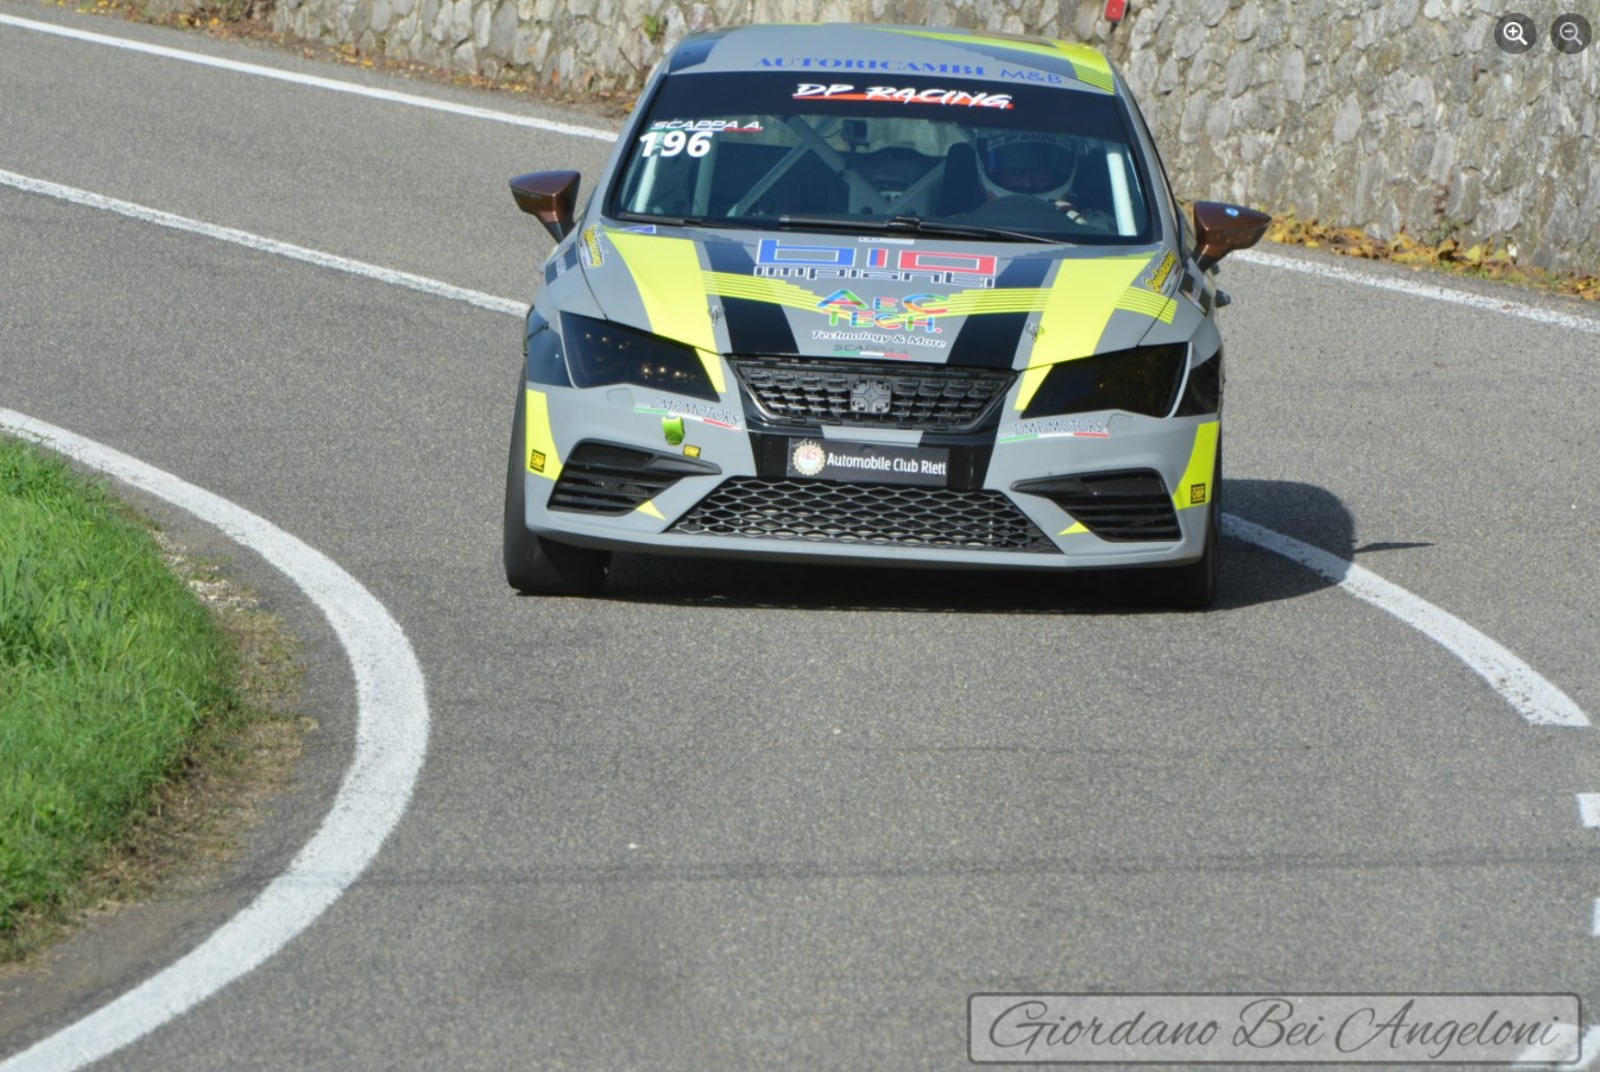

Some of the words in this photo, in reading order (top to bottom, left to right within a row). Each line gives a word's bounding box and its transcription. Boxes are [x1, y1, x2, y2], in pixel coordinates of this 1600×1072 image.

[754, 57, 985, 76] AUTORICAMBI
[1000, 69, 1063, 84] M&B
[792, 83, 855, 98] DP
[865, 86, 1012, 109] RACING
[650, 119, 738, 131] SCAPPA
[640, 130, 714, 158] 196
[811, 329, 890, 344] Technology
[893, 334, 905, 344] &
[907, 335, 947, 348] More
[650, 397, 682, 412] DMP
[682, 402, 741, 425] MOTORS
[1014, 422, 1044, 436] DMP
[1047, 419, 1104, 433] MOTORS
[826, 452, 891, 471] Automobile
[893, 457, 919, 474] Club
[920, 459, 947, 476] Rieti
